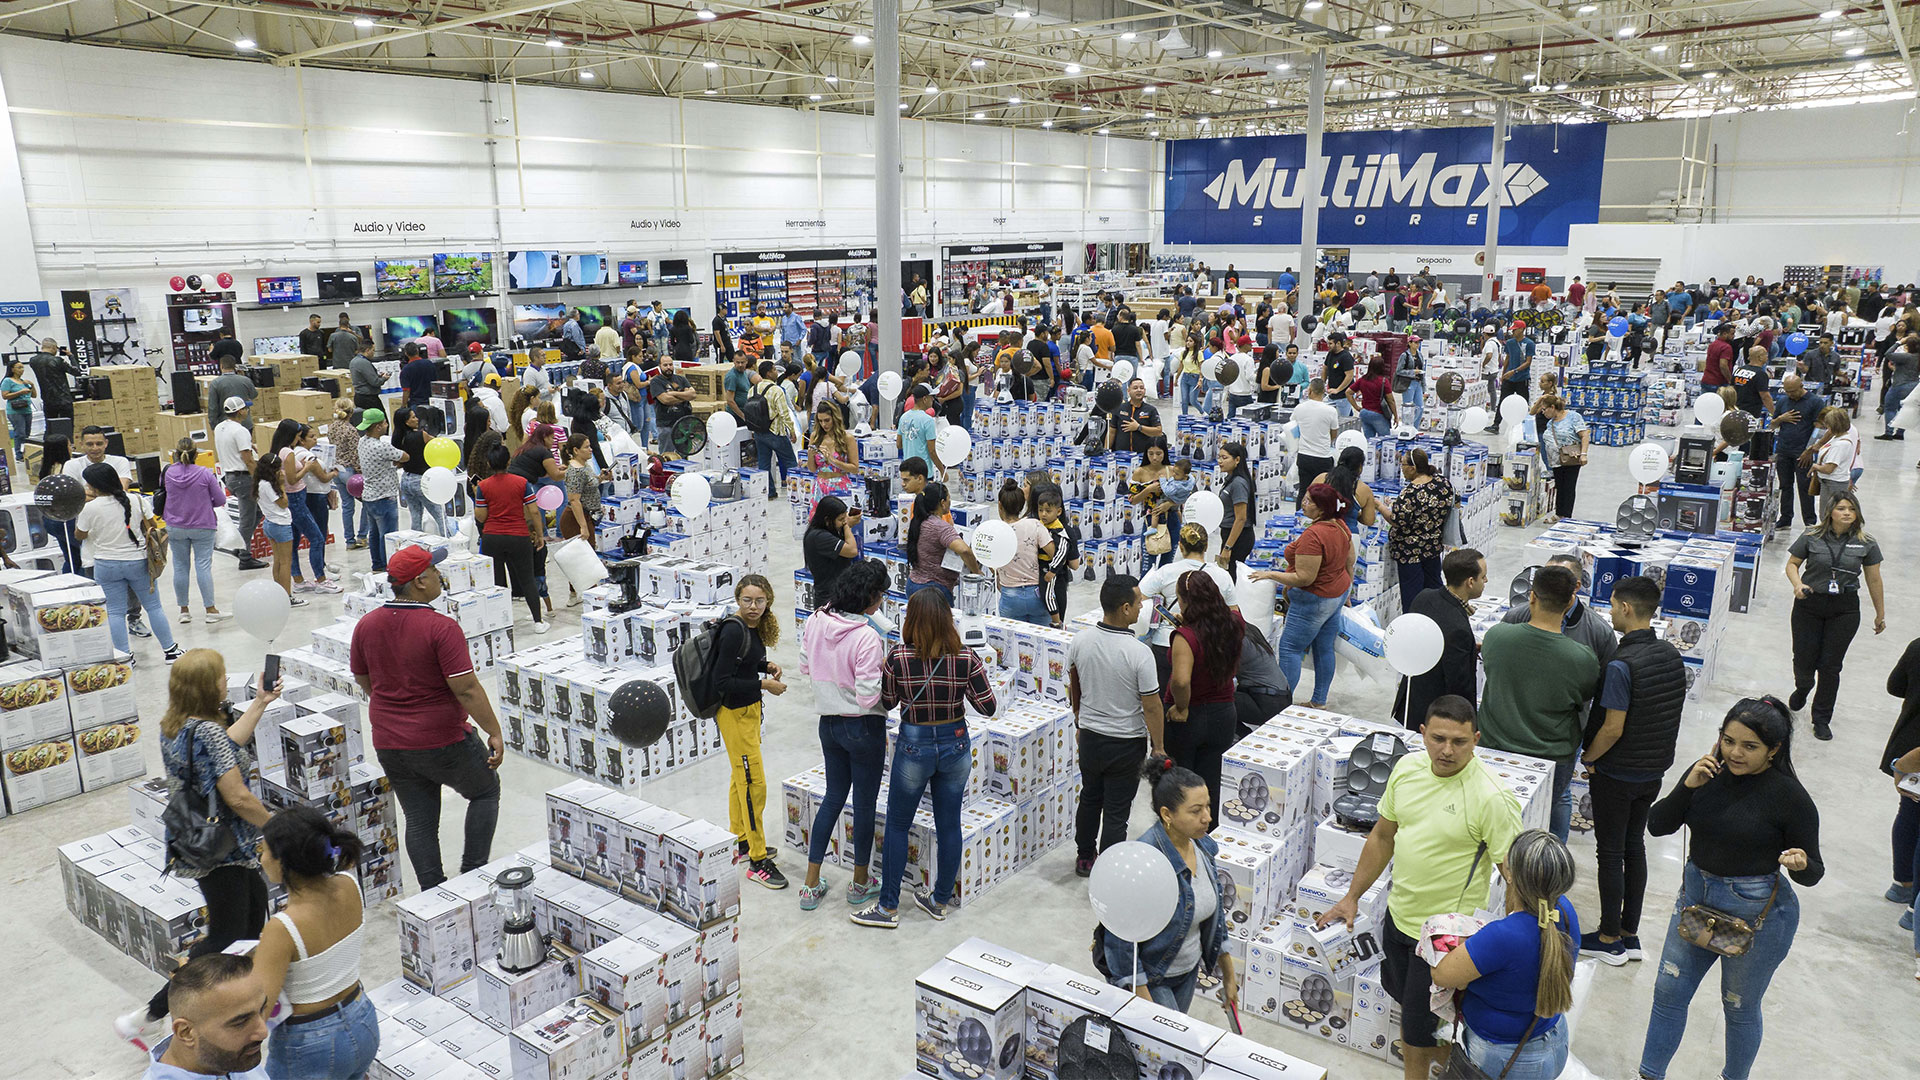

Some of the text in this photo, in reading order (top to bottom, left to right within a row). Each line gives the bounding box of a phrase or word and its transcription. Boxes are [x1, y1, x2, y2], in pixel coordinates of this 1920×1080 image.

[1218, 152, 1523, 210] MultiMax
[630, 219, 681, 230] Audio y Video
[785, 219, 826, 228] Herramientas
[1252, 213, 1478, 226] SORE
[353, 221, 426, 234] Audio y Video
[1416, 256, 1453, 266] Despacho
[709, 846, 730, 858] KUCCE
[1299, 886, 1327, 898] DAEWOO
[711, 925, 730, 938] KUCCE
[673, 945, 692, 960] KUCCE
[1283, 956, 1309, 968] DAEWOO
[634, 966, 654, 981] KUCCE
[1068, 981, 1099, 996] KUCCE
[715, 1001, 734, 1015] KUCCE
[921, 995, 942, 1008] KUCCE
[1031, 1001, 1054, 1014] KUCCE
[677, 1023, 697, 1038] KUCCE
[1154, 1016, 1188, 1032] KUCCE
[638, 1046, 659, 1061] KUCCE
[1250, 1053, 1287, 1071] KUCCE
